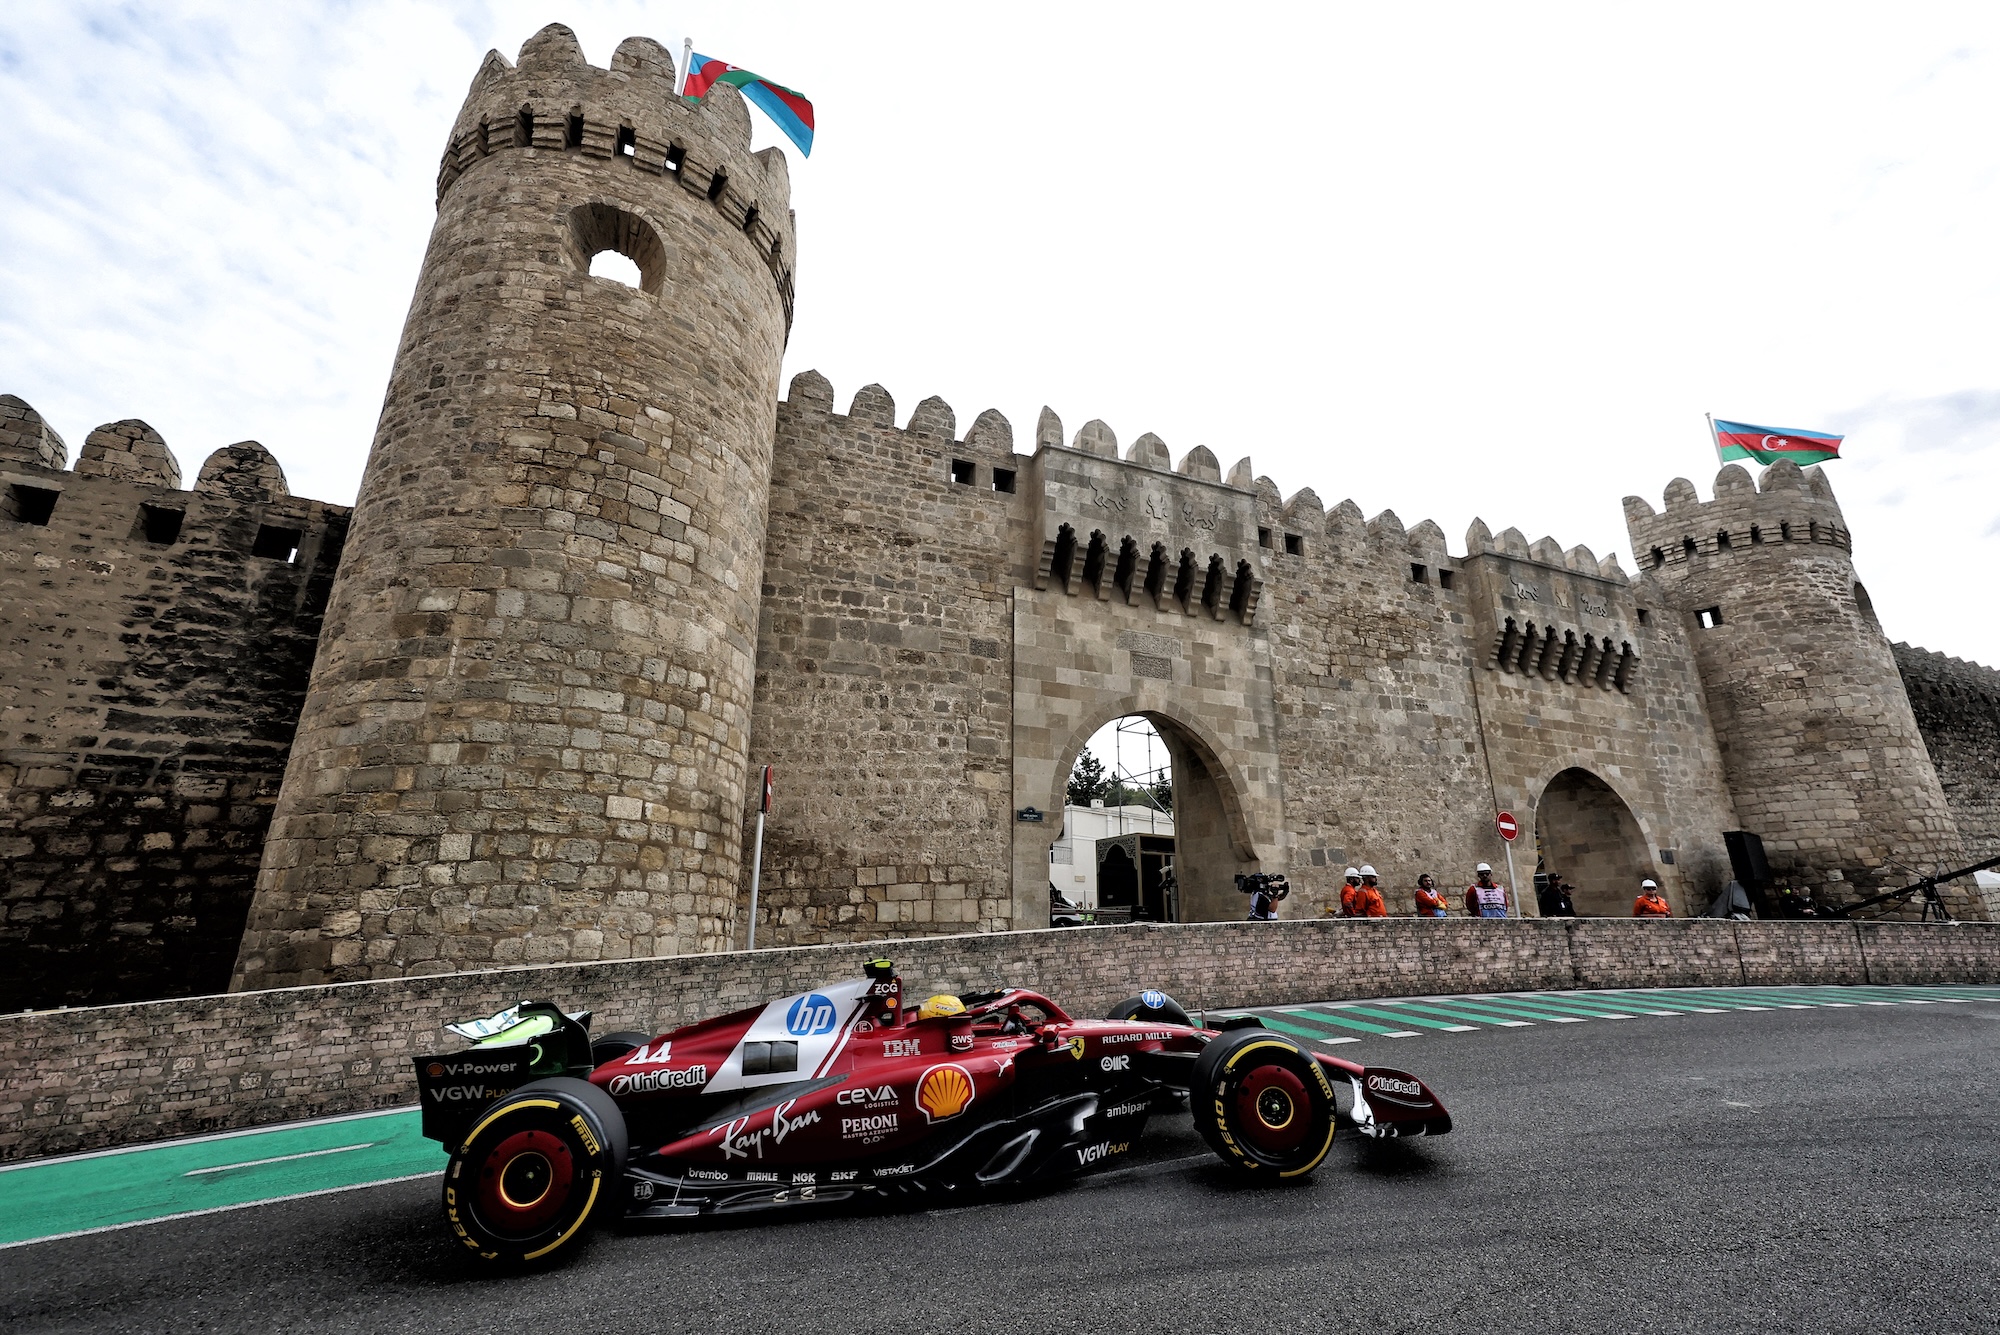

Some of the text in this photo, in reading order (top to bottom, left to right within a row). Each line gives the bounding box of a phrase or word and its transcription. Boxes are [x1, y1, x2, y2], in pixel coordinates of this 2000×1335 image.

[874, 983, 898, 993] ZCG
[1147, 991, 1161, 1007] hp
[792, 995, 832, 1031] hp
[952, 1035, 973, 1044] aws
[1102, 1031, 1172, 1044] RICHARD MILLE
[624, 1042, 672, 1065] 44
[883, 1039, 921, 1057] IBM
[445, 1062, 517, 1076] V-Power
[631, 1065, 706, 1092] UniCredit
[1310, 1062, 1333, 1099] PIRELLI
[1379, 1076, 1420, 1095] UniCredit
[430, 1085, 484, 1102] VGW
[864, 1100, 899, 1109] LOGISTICS
[1107, 1102, 1146, 1117] ambipar
[841, 1114, 898, 1133] PERONI
[869, 1127, 898, 1136] AZZURRO
[1215, 1100, 1244, 1157] ZERO
[570, 1114, 600, 1156] PIRELLI
[1077, 1141, 1129, 1165] VGW PLAY
[689, 1167, 728, 1181] brembo
[746, 1172, 778, 1182] MAHLE
[792, 1173, 816, 1183] NGK
[831, 1171, 858, 1181] SKF
[447, 1187, 479, 1249] ZERO
